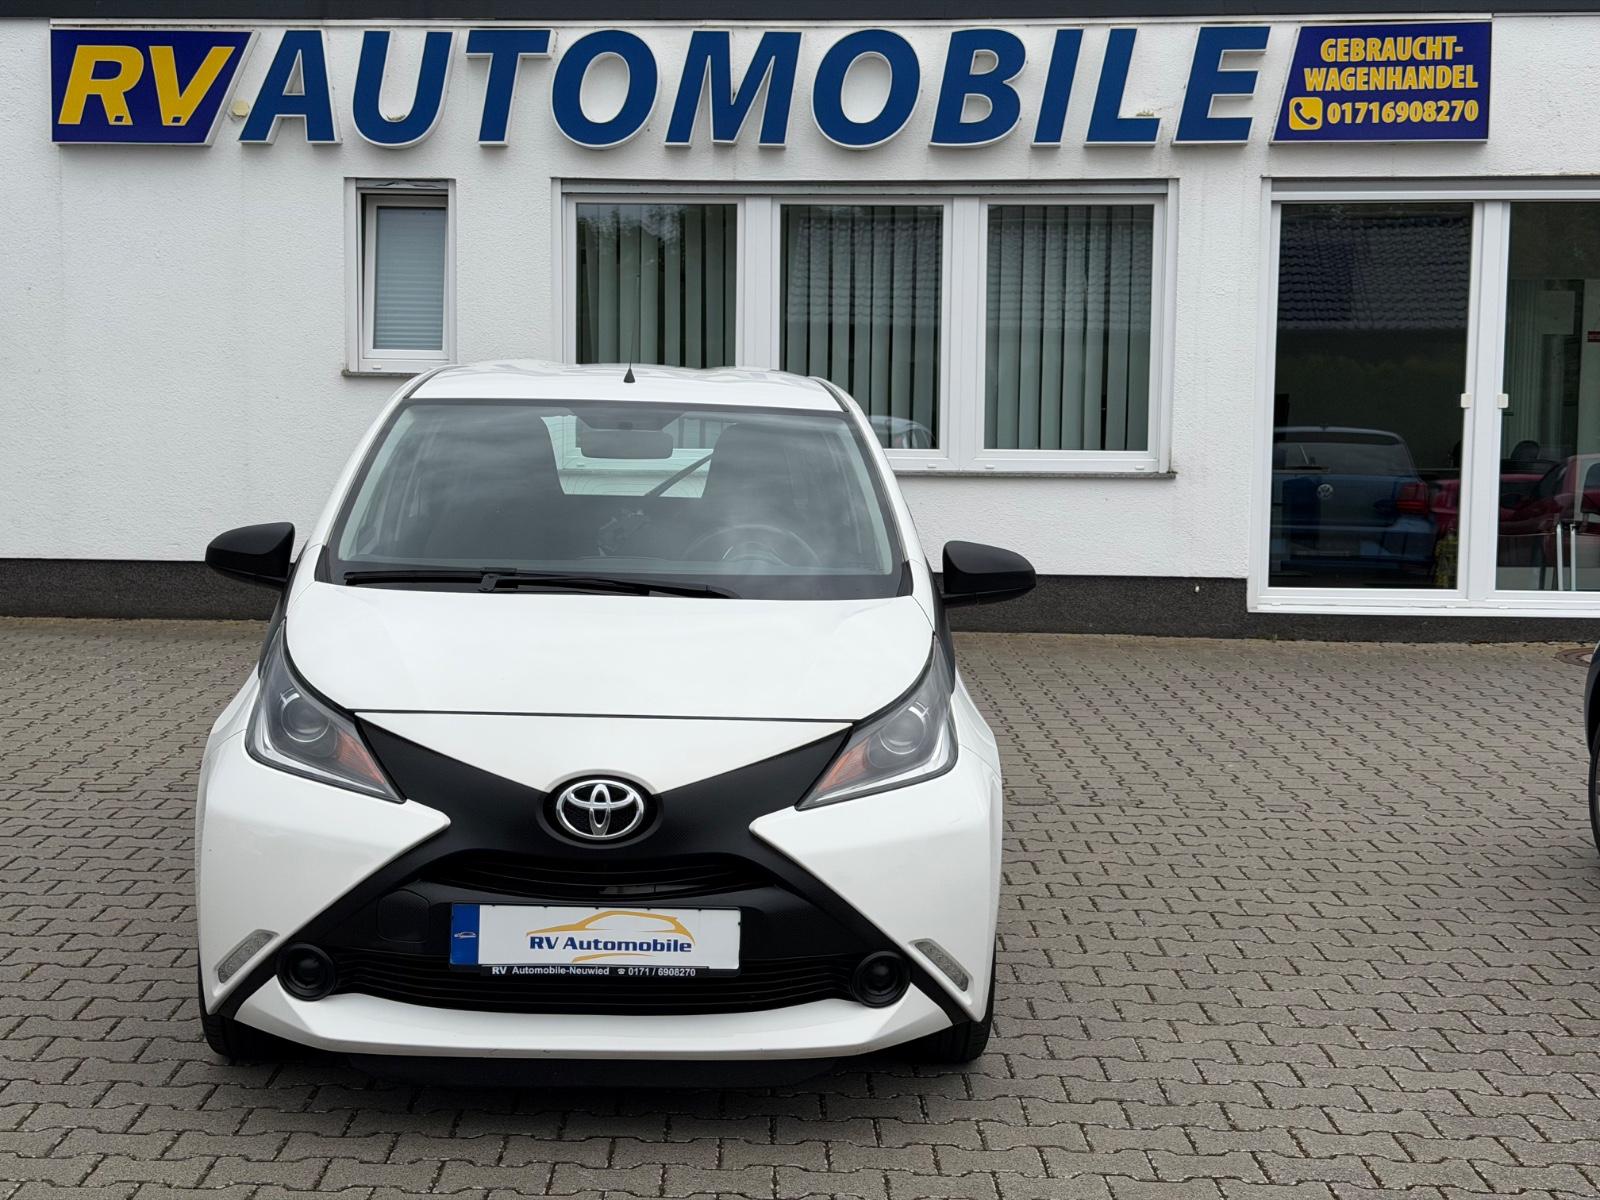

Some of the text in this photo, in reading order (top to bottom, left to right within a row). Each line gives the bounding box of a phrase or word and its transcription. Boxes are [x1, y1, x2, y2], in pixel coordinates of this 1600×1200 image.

[1320, 36, 1464, 62] GEBRAUCHT-
[238, 25, 1271, 148] AUTOMOBILE
[1303, 64, 1479, 92] WAGENHANDEL
[1326, 99, 1479, 124] 01716908270
[529, 936, 692, 952] RV Automobile
[491, 966, 507, 975] RV
[512, 966, 610, 975] Automobile-Neuwied
[628, 967, 650, 976] 0171
[657, 968, 696, 977] 6908270
